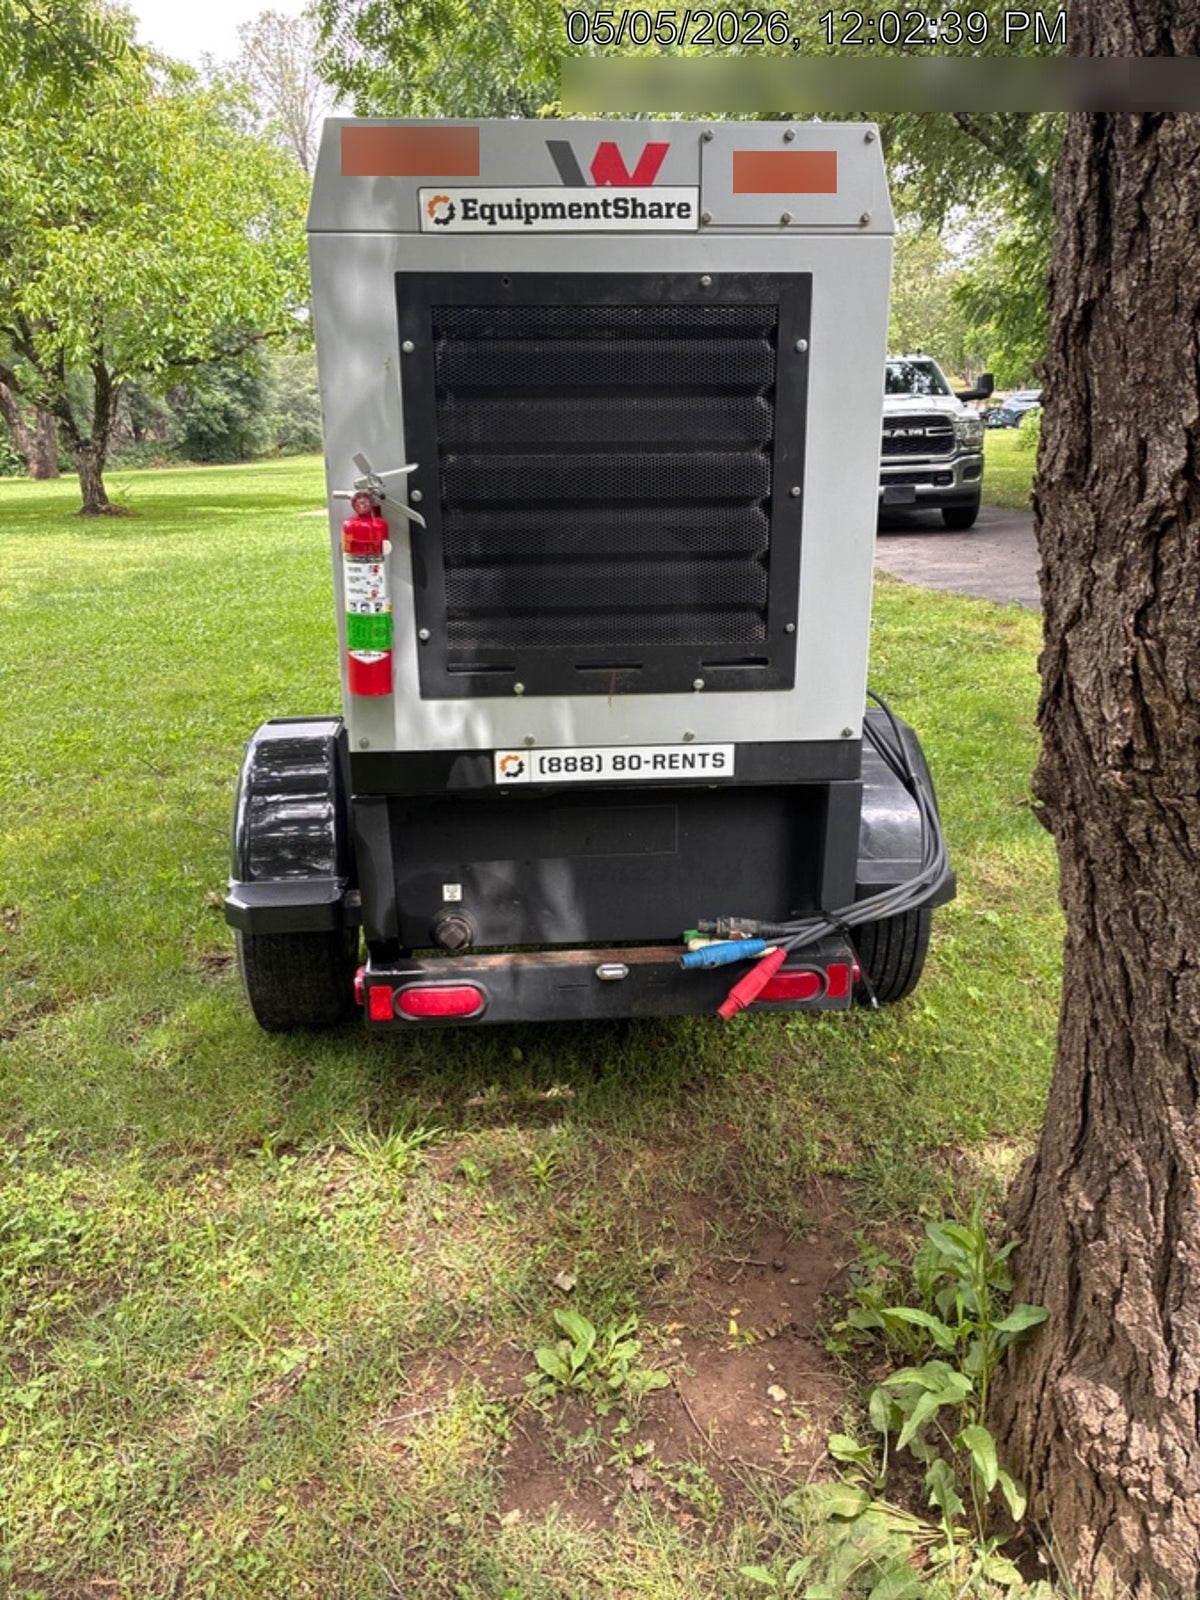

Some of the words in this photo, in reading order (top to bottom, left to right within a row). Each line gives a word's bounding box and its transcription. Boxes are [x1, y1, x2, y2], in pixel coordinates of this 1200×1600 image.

[460, 197, 692, 226] EquipmentShare
[538, 755, 603, 775] (888)
[612, 752, 726, 771] 80-RENTS
